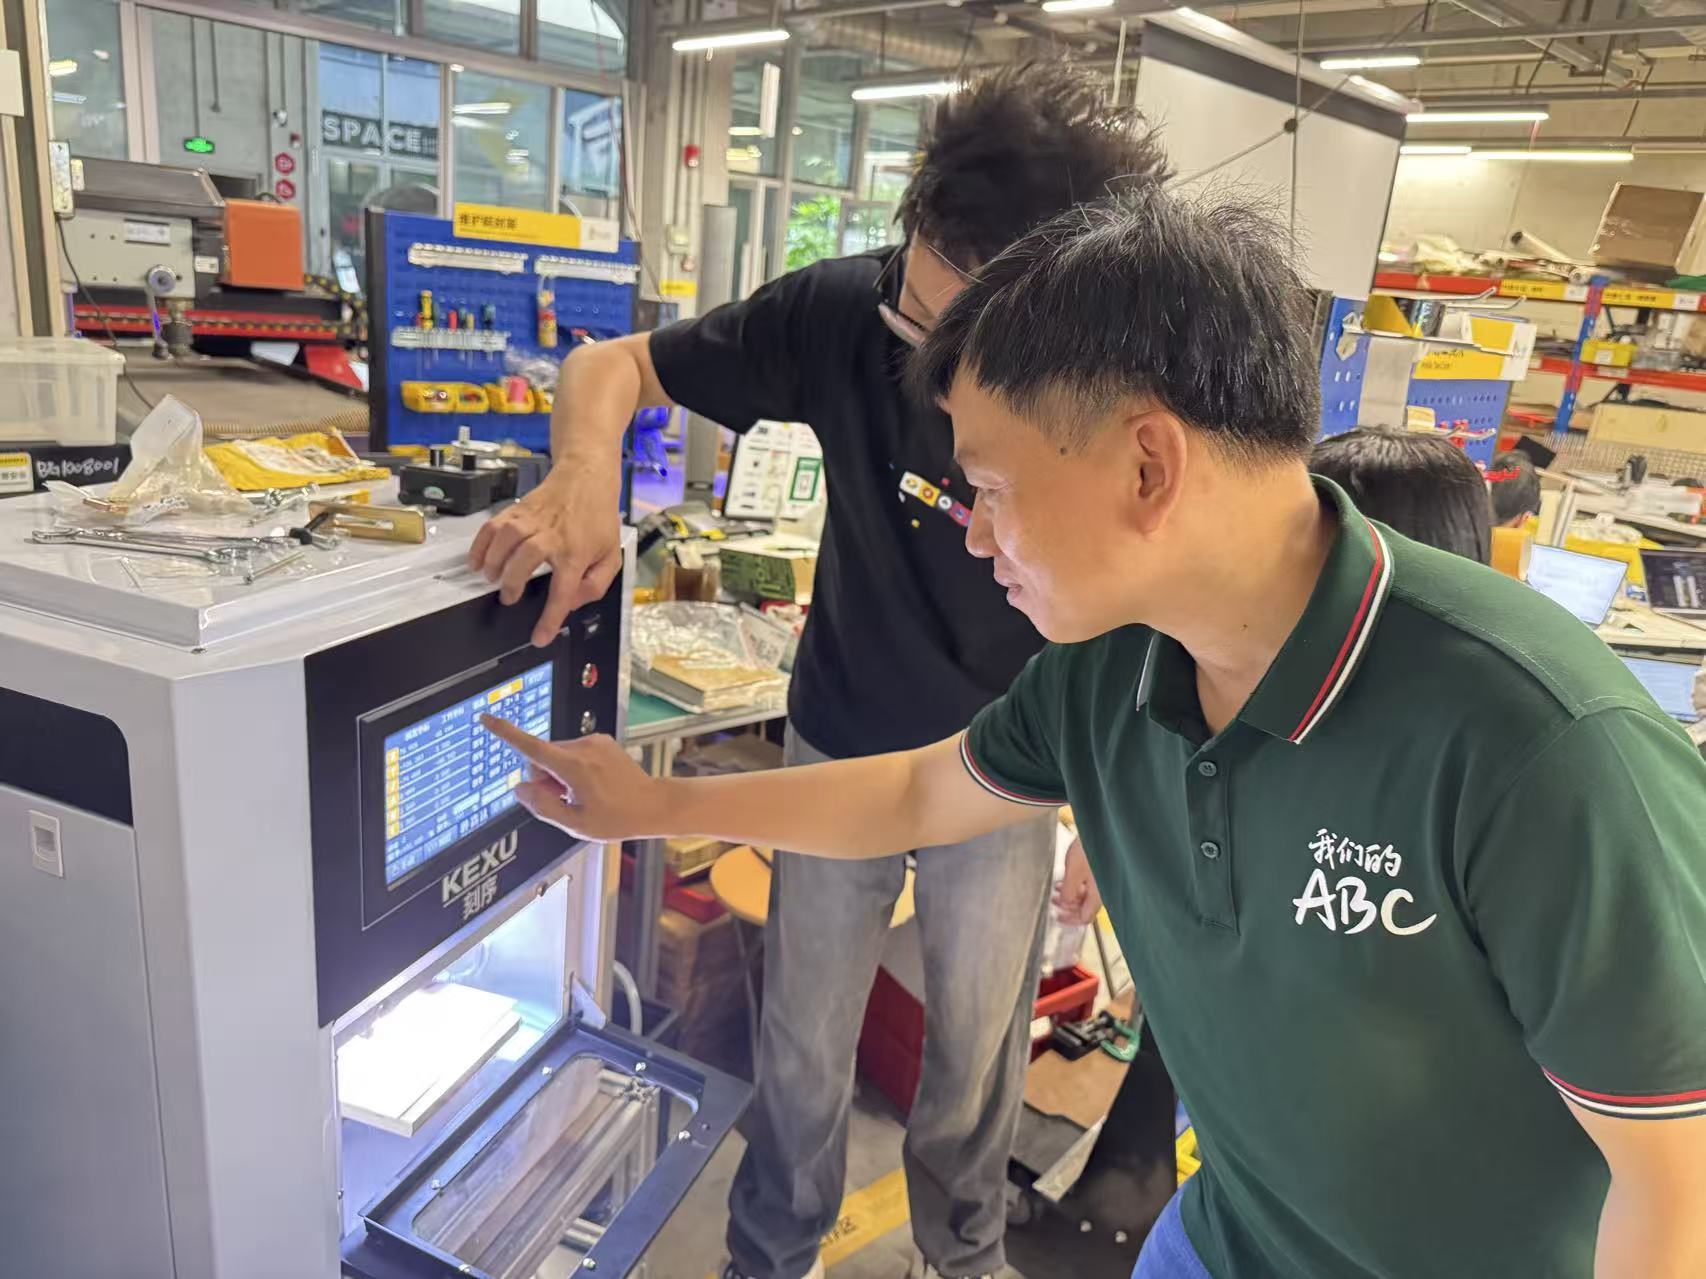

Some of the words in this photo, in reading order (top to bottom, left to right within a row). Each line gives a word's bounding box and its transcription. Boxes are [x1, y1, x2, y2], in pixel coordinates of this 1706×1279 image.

[323, 115, 421, 153] SPACE
[442, 829, 518, 903] KEXU
[1308, 828, 1402, 877] 我们的
[463, 874, 498, 921] 刻序
[1292, 868, 1438, 936] ABC
